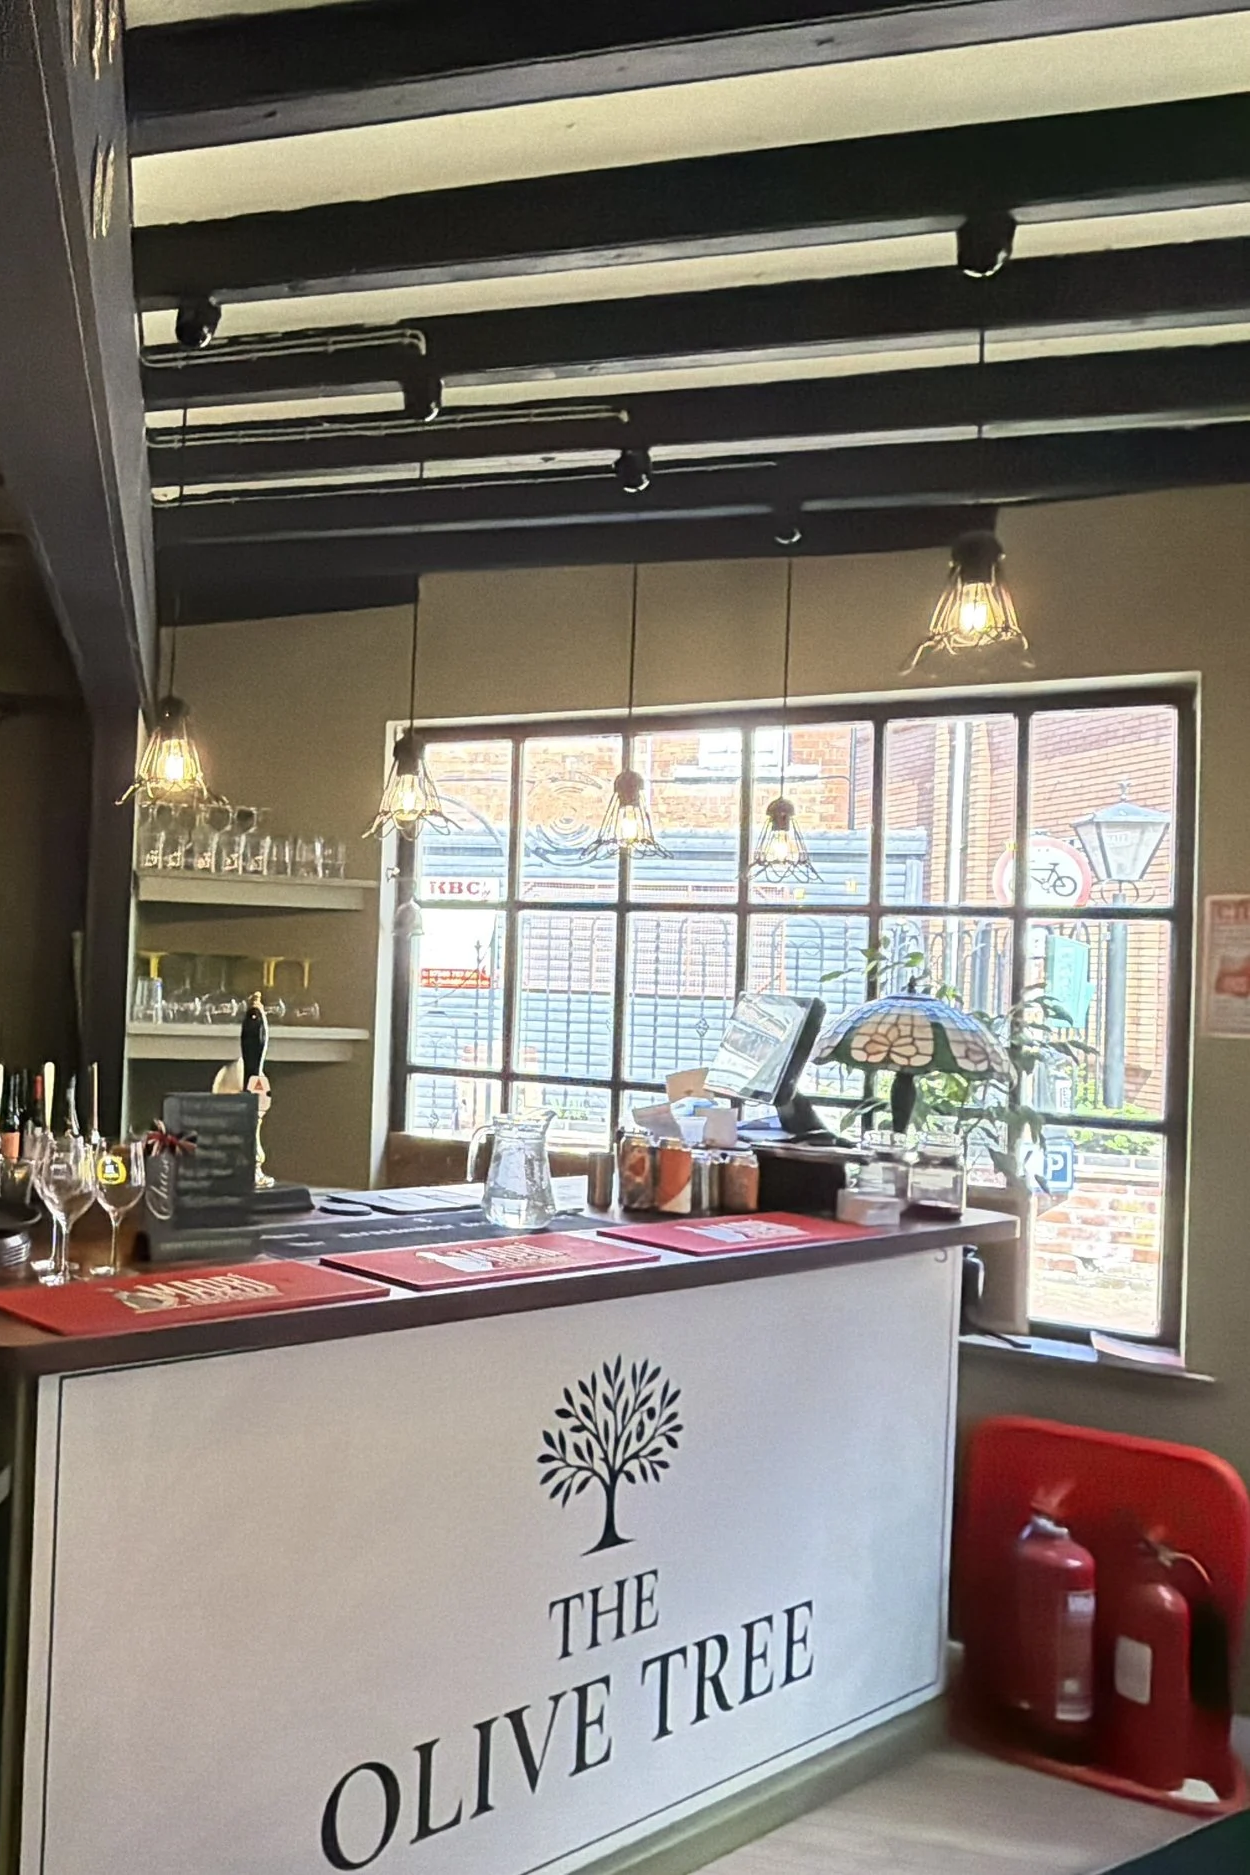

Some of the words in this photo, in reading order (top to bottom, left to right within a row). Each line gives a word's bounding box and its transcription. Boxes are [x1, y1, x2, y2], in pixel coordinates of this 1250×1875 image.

[1047, 1152, 1064, 1171] P
[548, 1568, 660, 1660] THE
[319, 1673, 614, 1872] OLIVE
[640, 1599, 815, 1742] TREE
